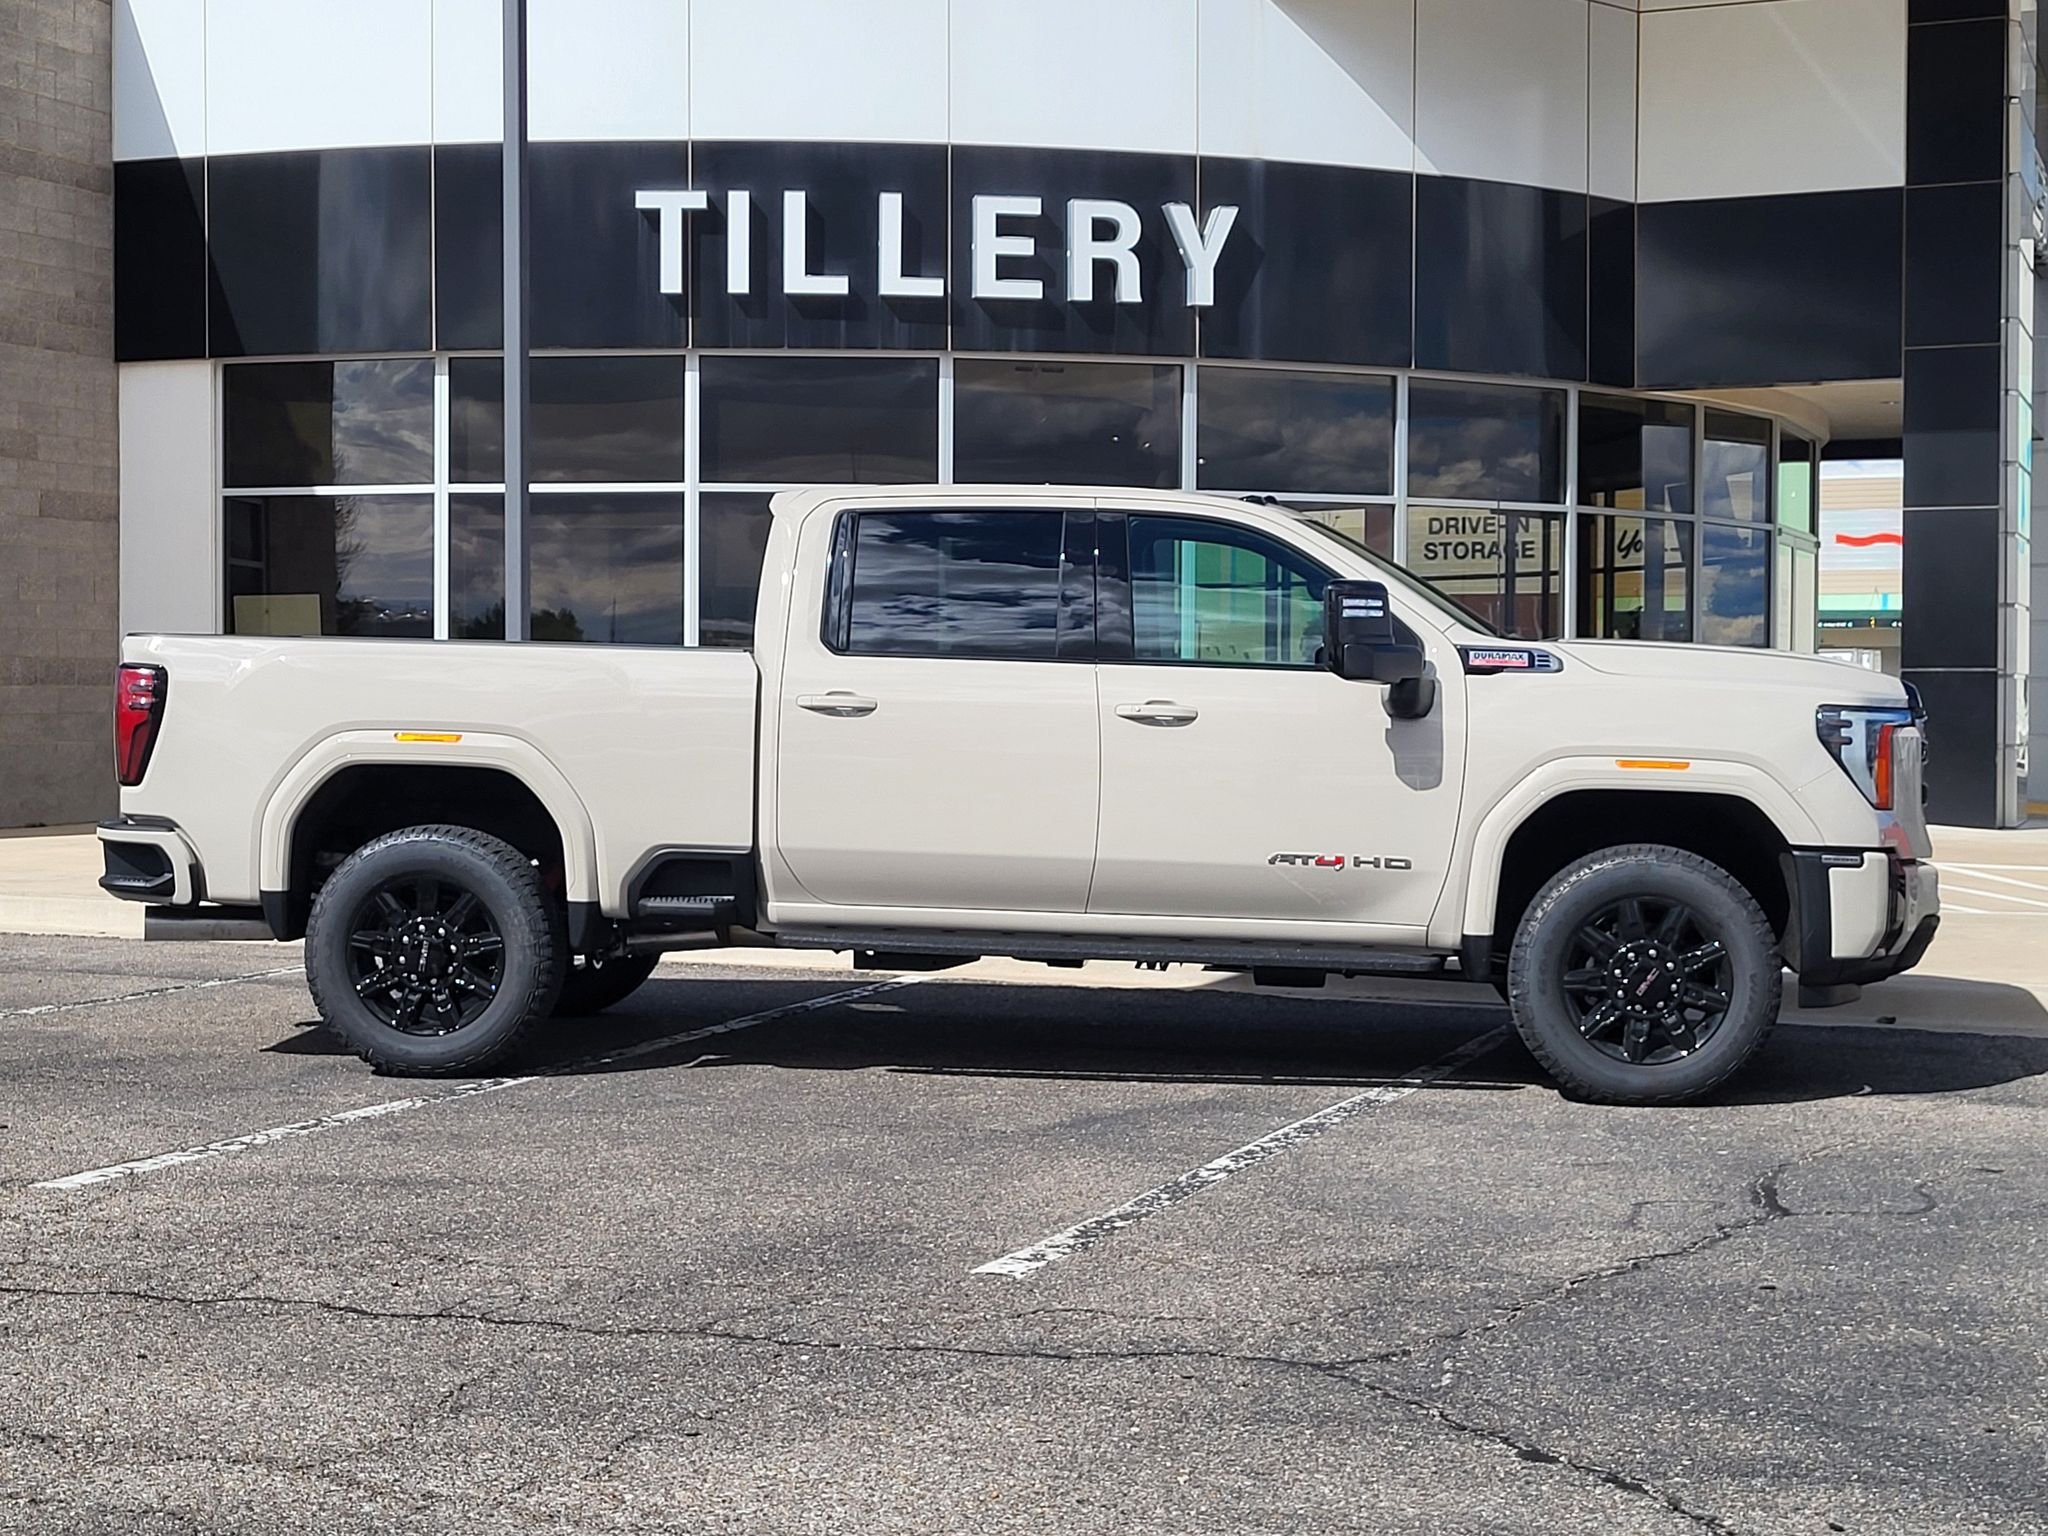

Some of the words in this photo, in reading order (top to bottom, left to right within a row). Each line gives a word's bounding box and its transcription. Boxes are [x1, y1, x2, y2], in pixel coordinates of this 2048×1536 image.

[635, 190, 1238, 305] TILLERY
[1428, 515, 1529, 535] DRIVE-N
[1473, 652, 1524, 661] DURAMAX
[1268, 853, 1344, 871] AT4
[1353, 856, 1412, 870] HD
